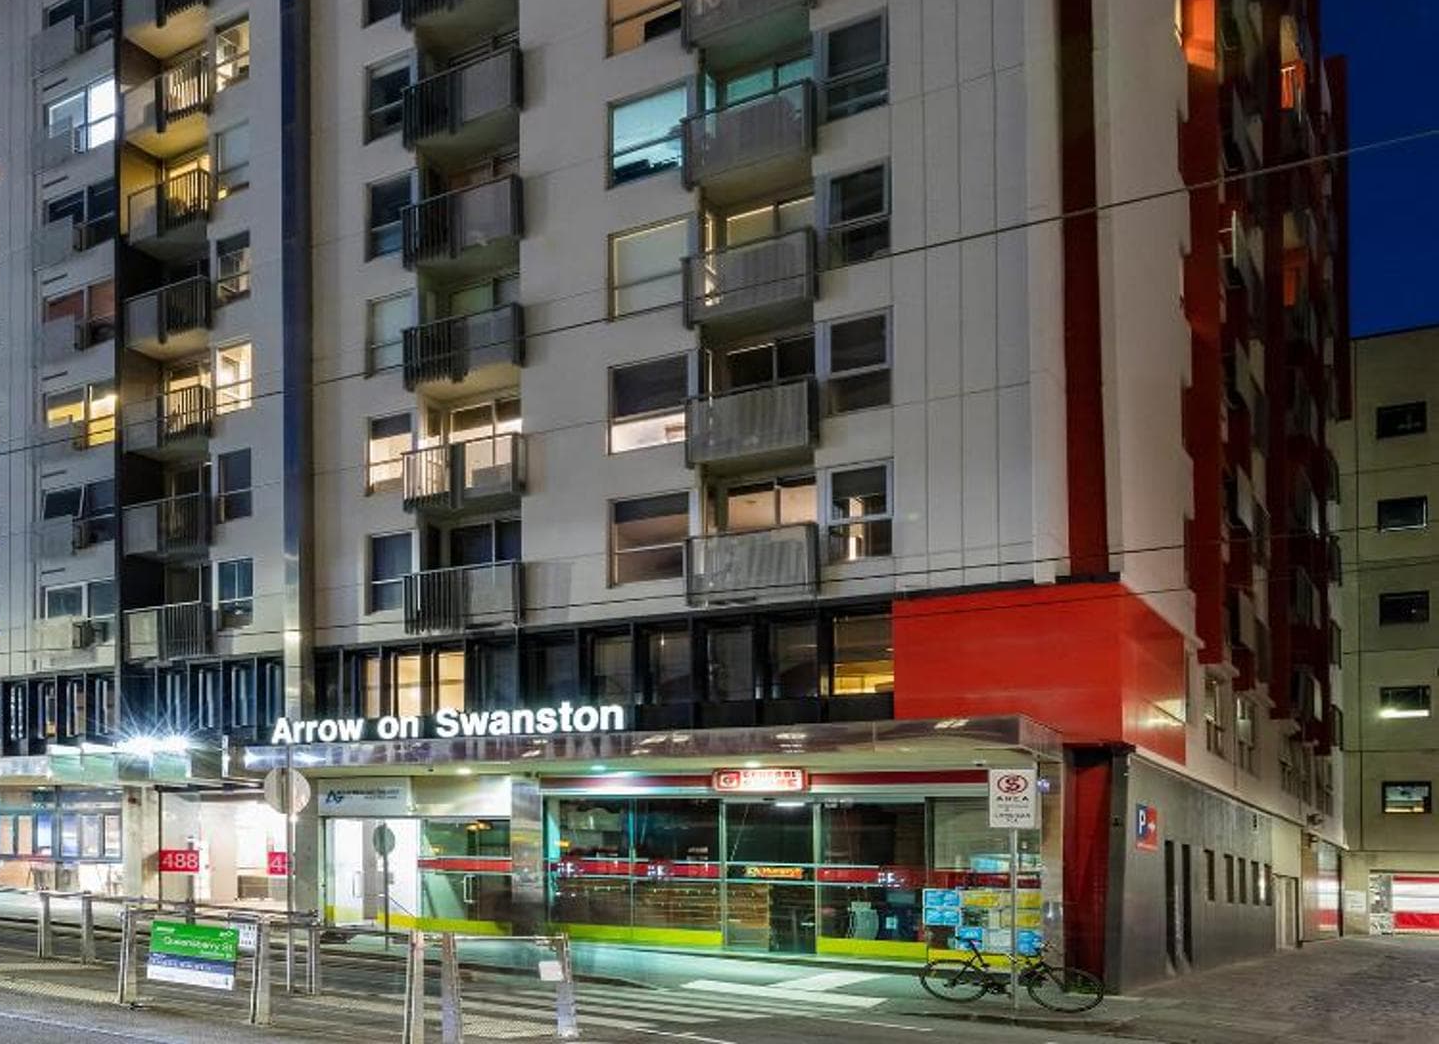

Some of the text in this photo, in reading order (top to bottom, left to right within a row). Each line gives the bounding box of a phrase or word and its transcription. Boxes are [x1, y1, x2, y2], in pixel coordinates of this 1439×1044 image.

[271, 700, 624, 744] Arrow on Swanston
[1139, 809, 1146, 834] P
[162, 852, 199, 869] 488
